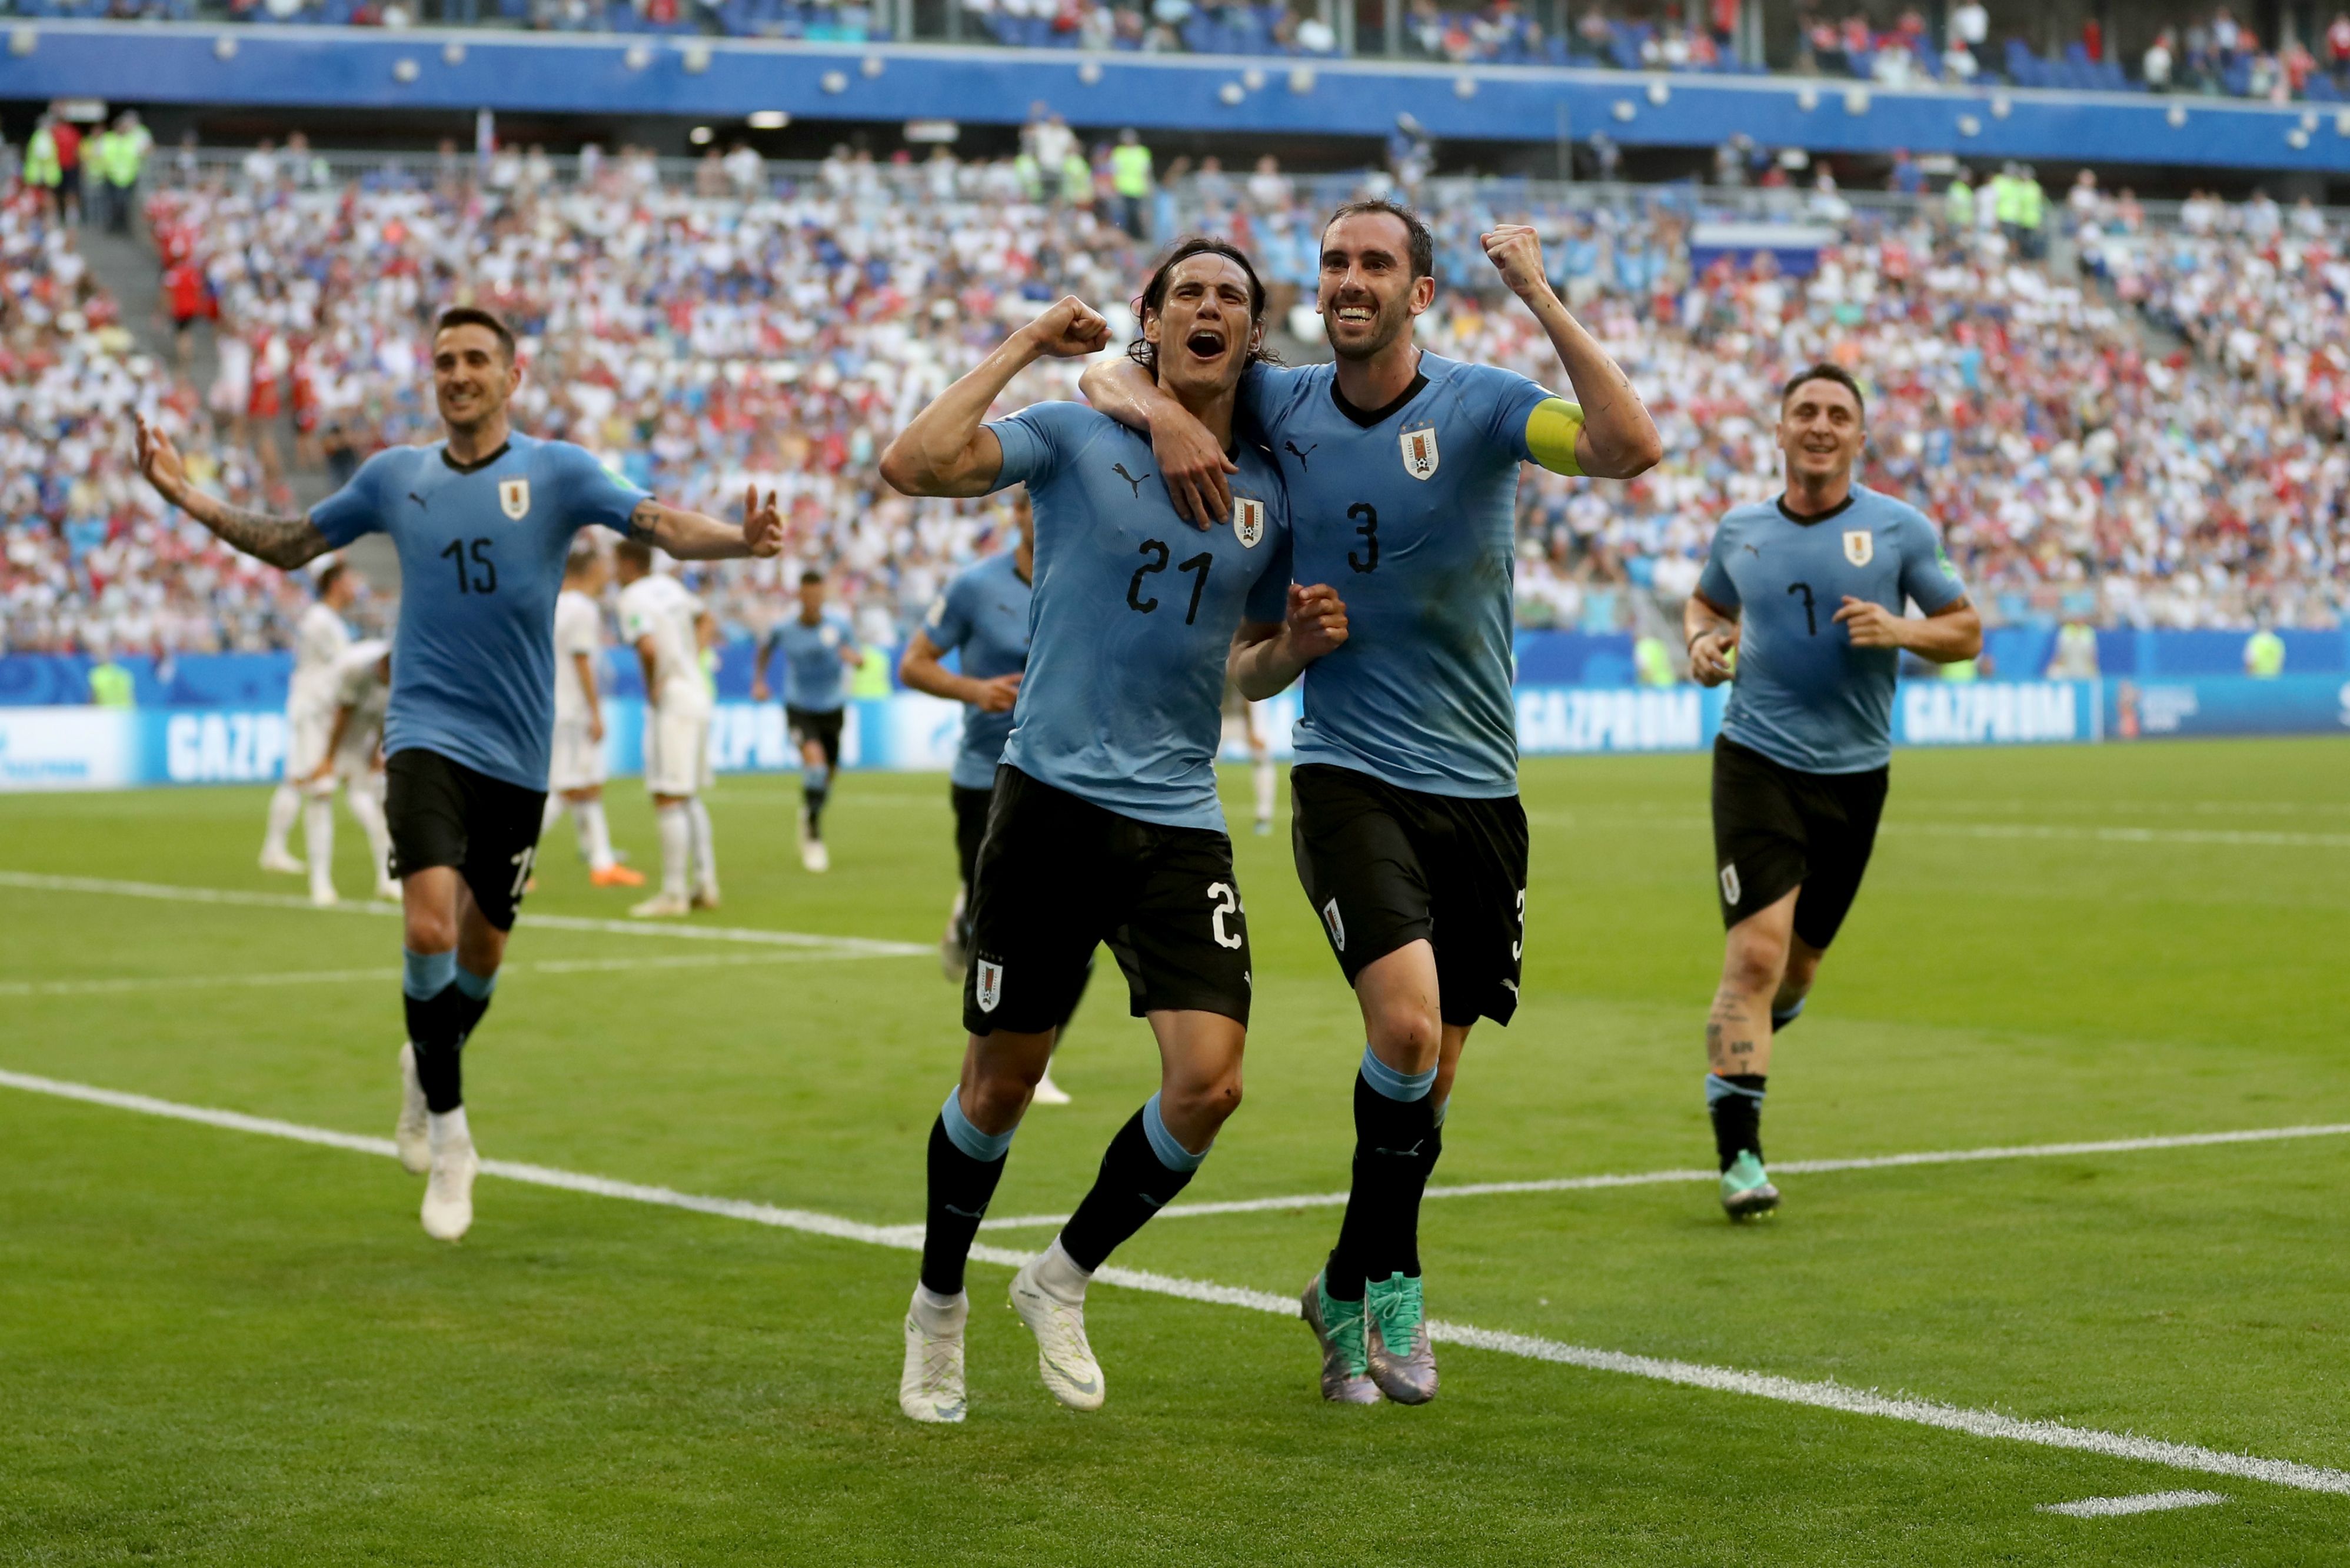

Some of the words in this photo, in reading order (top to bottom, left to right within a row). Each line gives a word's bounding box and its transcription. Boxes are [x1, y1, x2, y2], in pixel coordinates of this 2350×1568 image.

[441, 537, 498, 594] 15
[1346, 502, 1379, 574] 3
[1126, 538, 1213, 625] 21
[1787, 582, 1817, 637] 7
[1517, 691, 1700, 750] GAZPROM
[1905, 683, 2075, 743] GAZPROM
[167, 713, 287, 783] GAZP
[1207, 882, 1244, 950] 2
